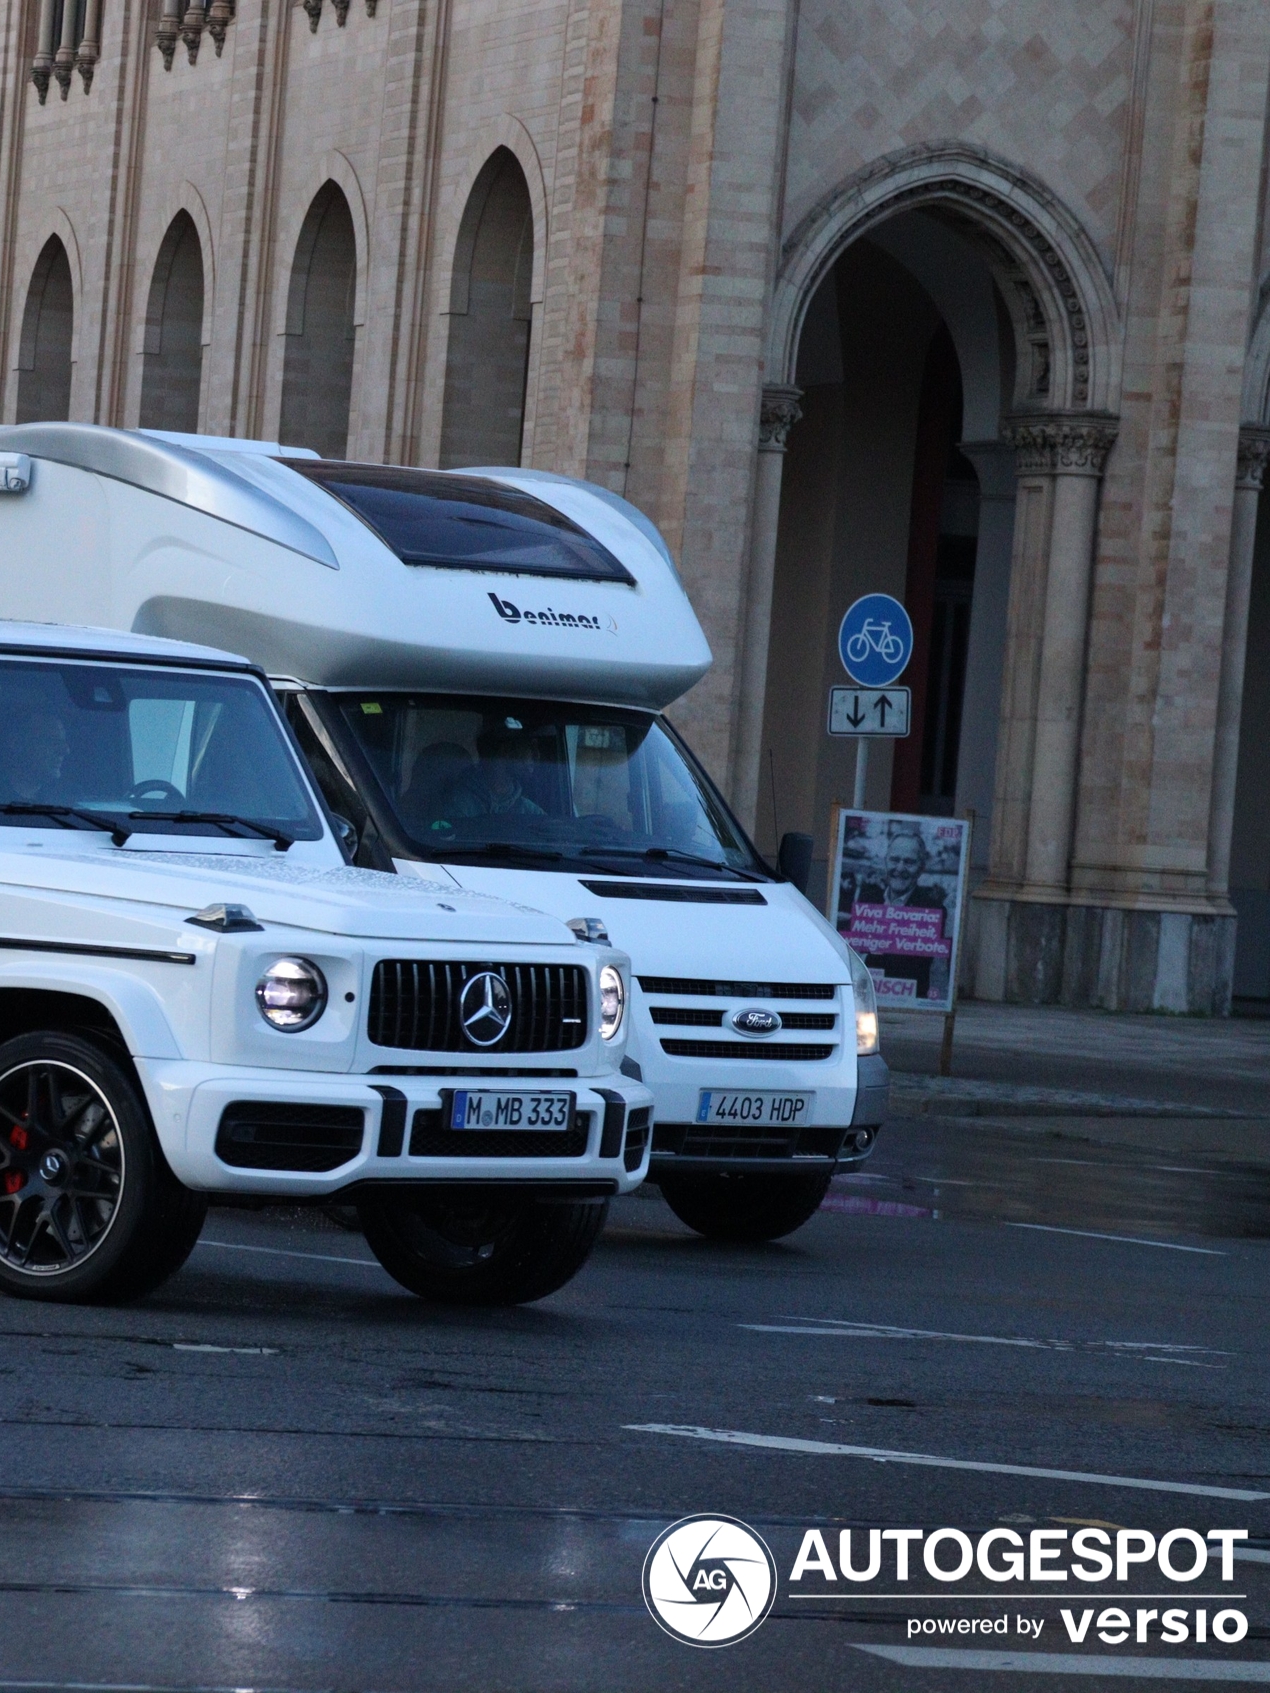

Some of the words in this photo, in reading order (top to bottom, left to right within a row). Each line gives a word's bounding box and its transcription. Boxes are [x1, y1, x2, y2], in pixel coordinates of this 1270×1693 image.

[855, 904, 883, 918] Viva
[886, 908, 941, 924] Bavaria:
[851, 919, 886, 934] Mehr
[888, 922, 938, 940] Freiheit,
[895, 937, 949, 954] Verbote.
[746, 1012, 773, 1028] Ford
[467, 1096, 482, 1125] M
[495, 1097, 523, 1126] MB
[527, 1098, 568, 1126] 333
[715, 1096, 764, 1121] 4403
[769, 1098, 805, 1122] HDP
